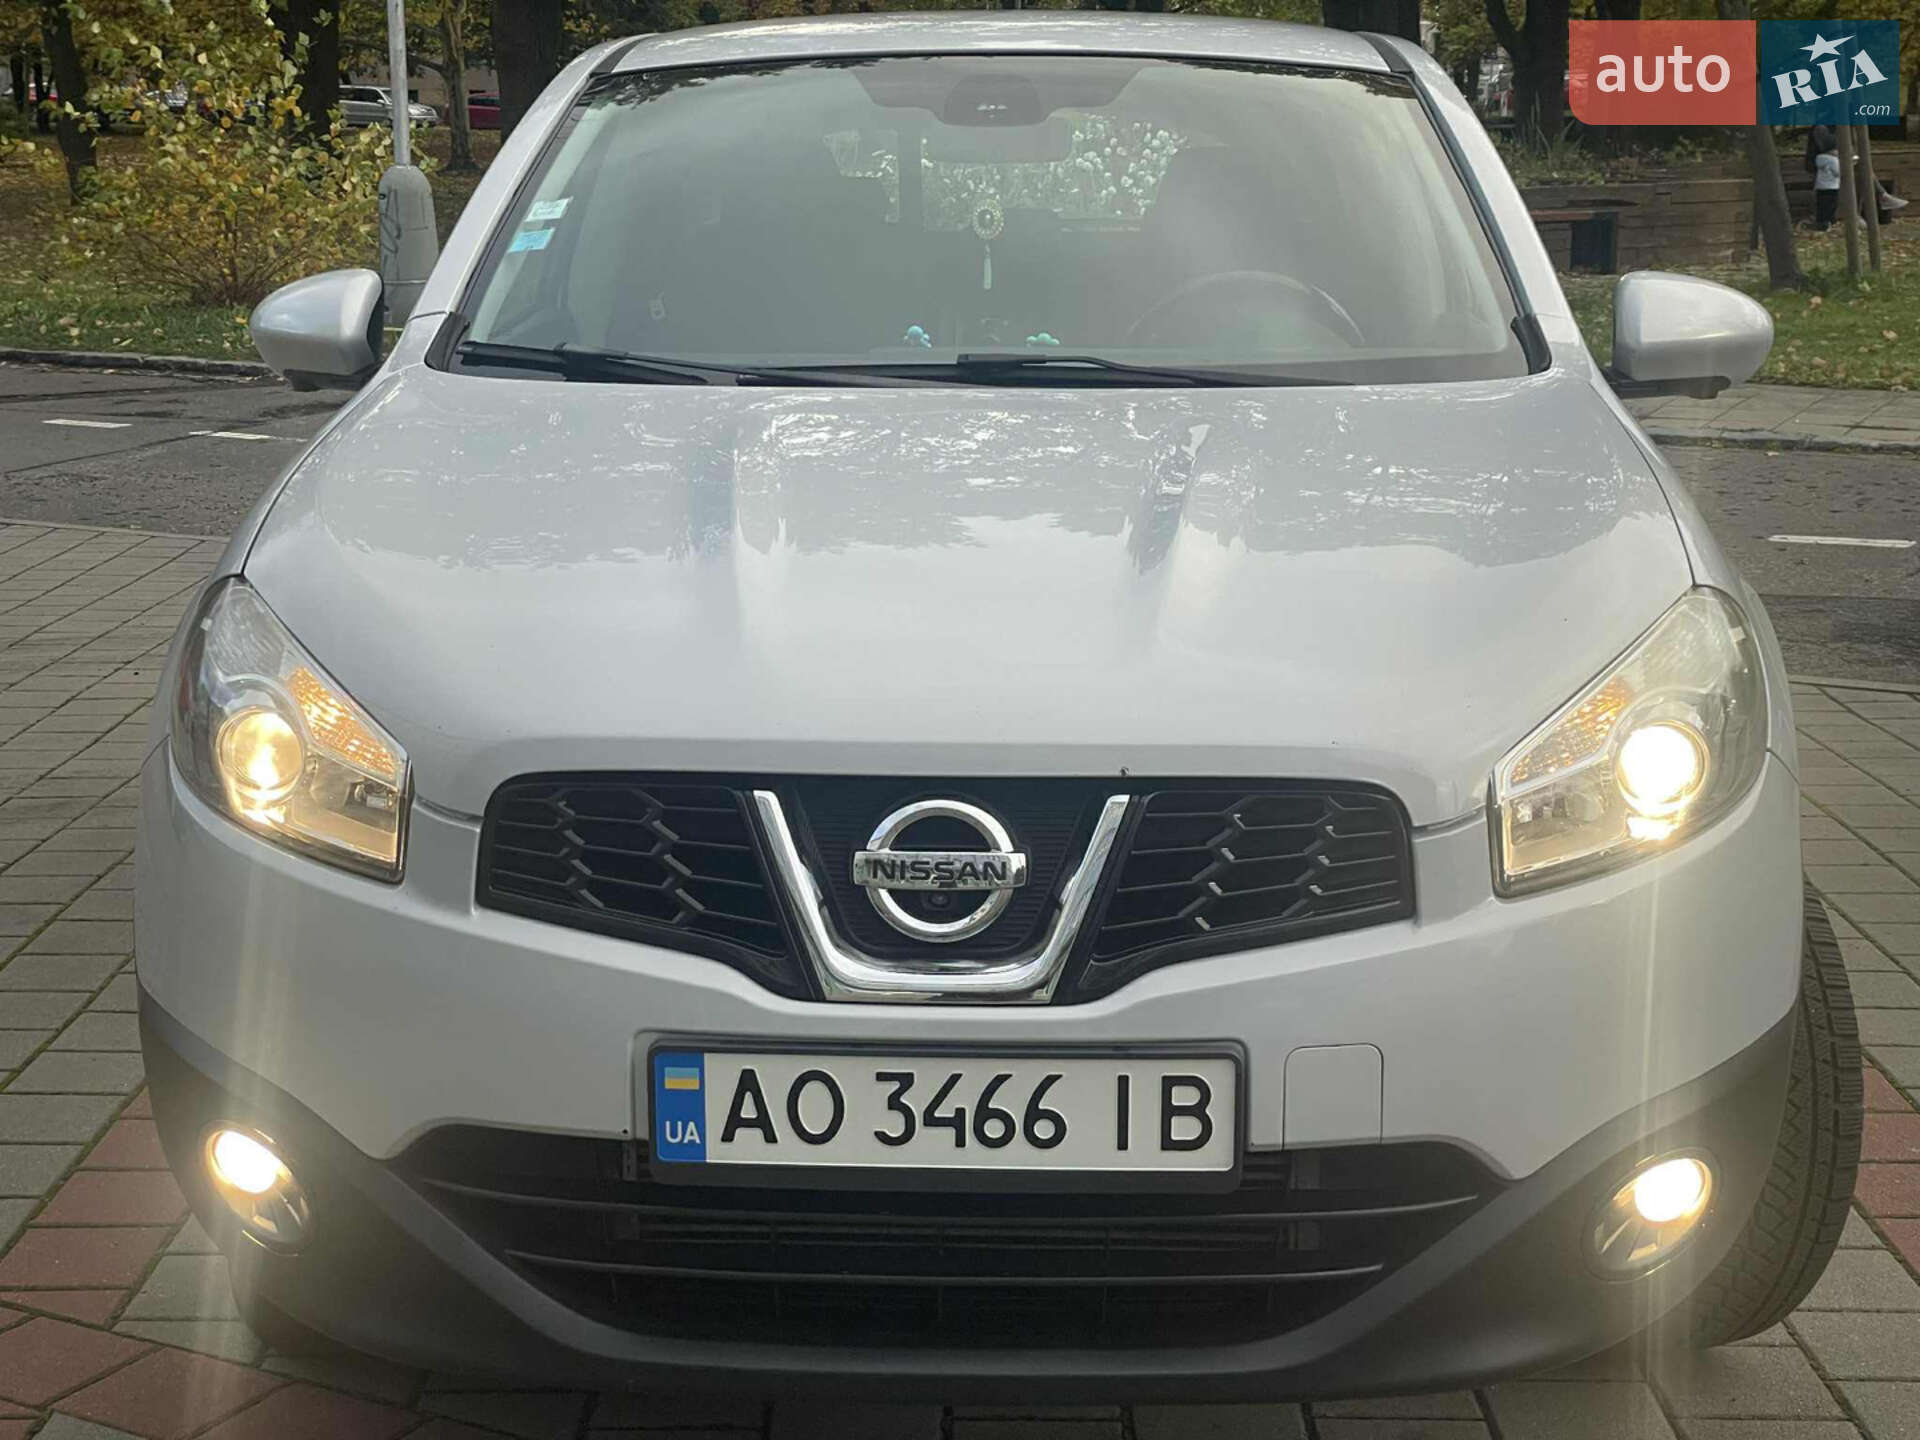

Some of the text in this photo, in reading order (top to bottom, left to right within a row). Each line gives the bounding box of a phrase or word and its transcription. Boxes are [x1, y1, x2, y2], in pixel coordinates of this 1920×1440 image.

[869, 859, 1008, 881] NISSAN
[720, 1068, 1213, 1152] AO 3466 IB
[665, 1121, 701, 1145] UA
